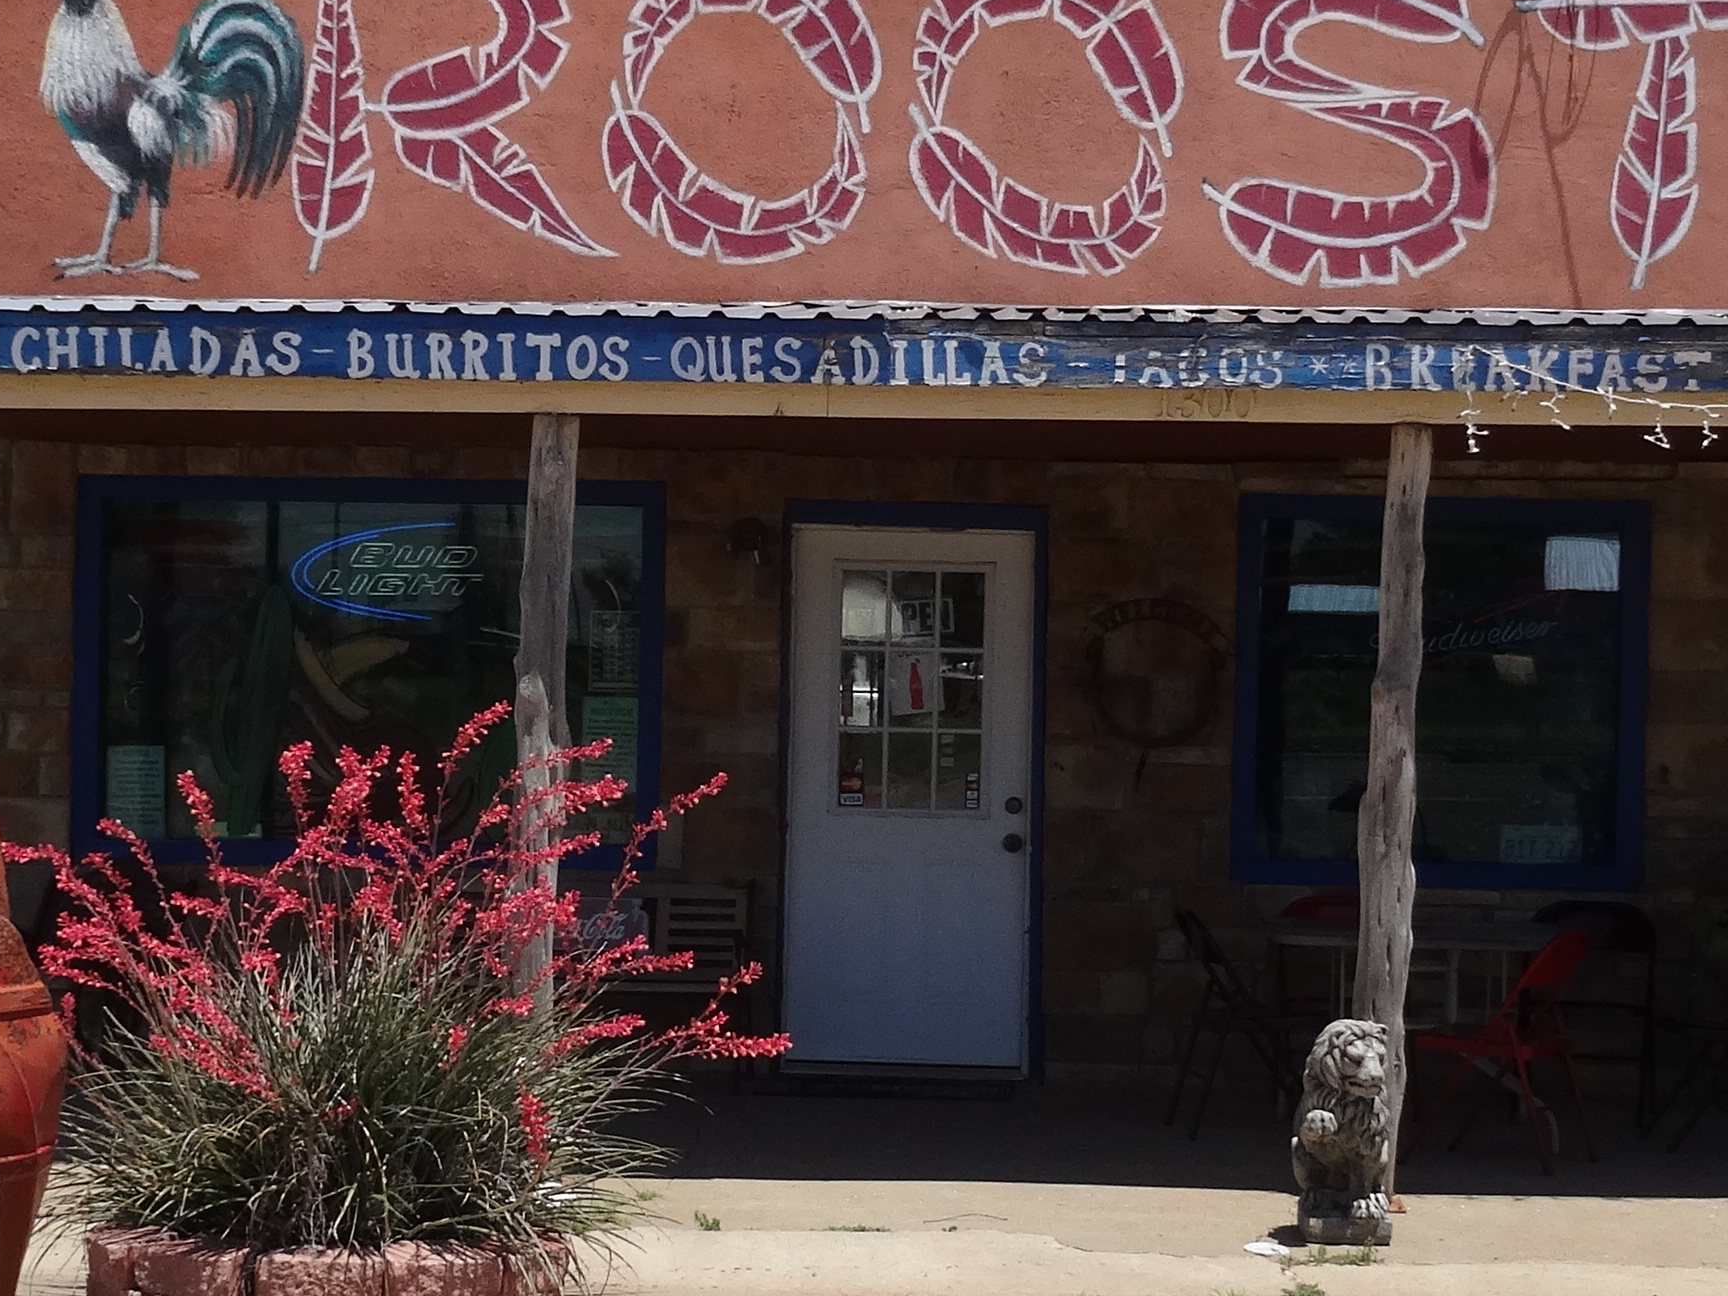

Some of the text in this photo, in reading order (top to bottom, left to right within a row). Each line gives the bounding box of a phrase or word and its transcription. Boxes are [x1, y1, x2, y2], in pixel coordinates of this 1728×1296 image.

[347, 328, 630, 383] BURRITOS
[670, 334, 1049, 388] QUESADILLAS
[1364, 342, 1712, 394] BREAKFAST
[348, 542, 478, 568] BUD
[317, 572, 483, 596] LIGHT
[896, 602, 950, 632] PEN
[1370, 619, 1557, 653] udweiser
